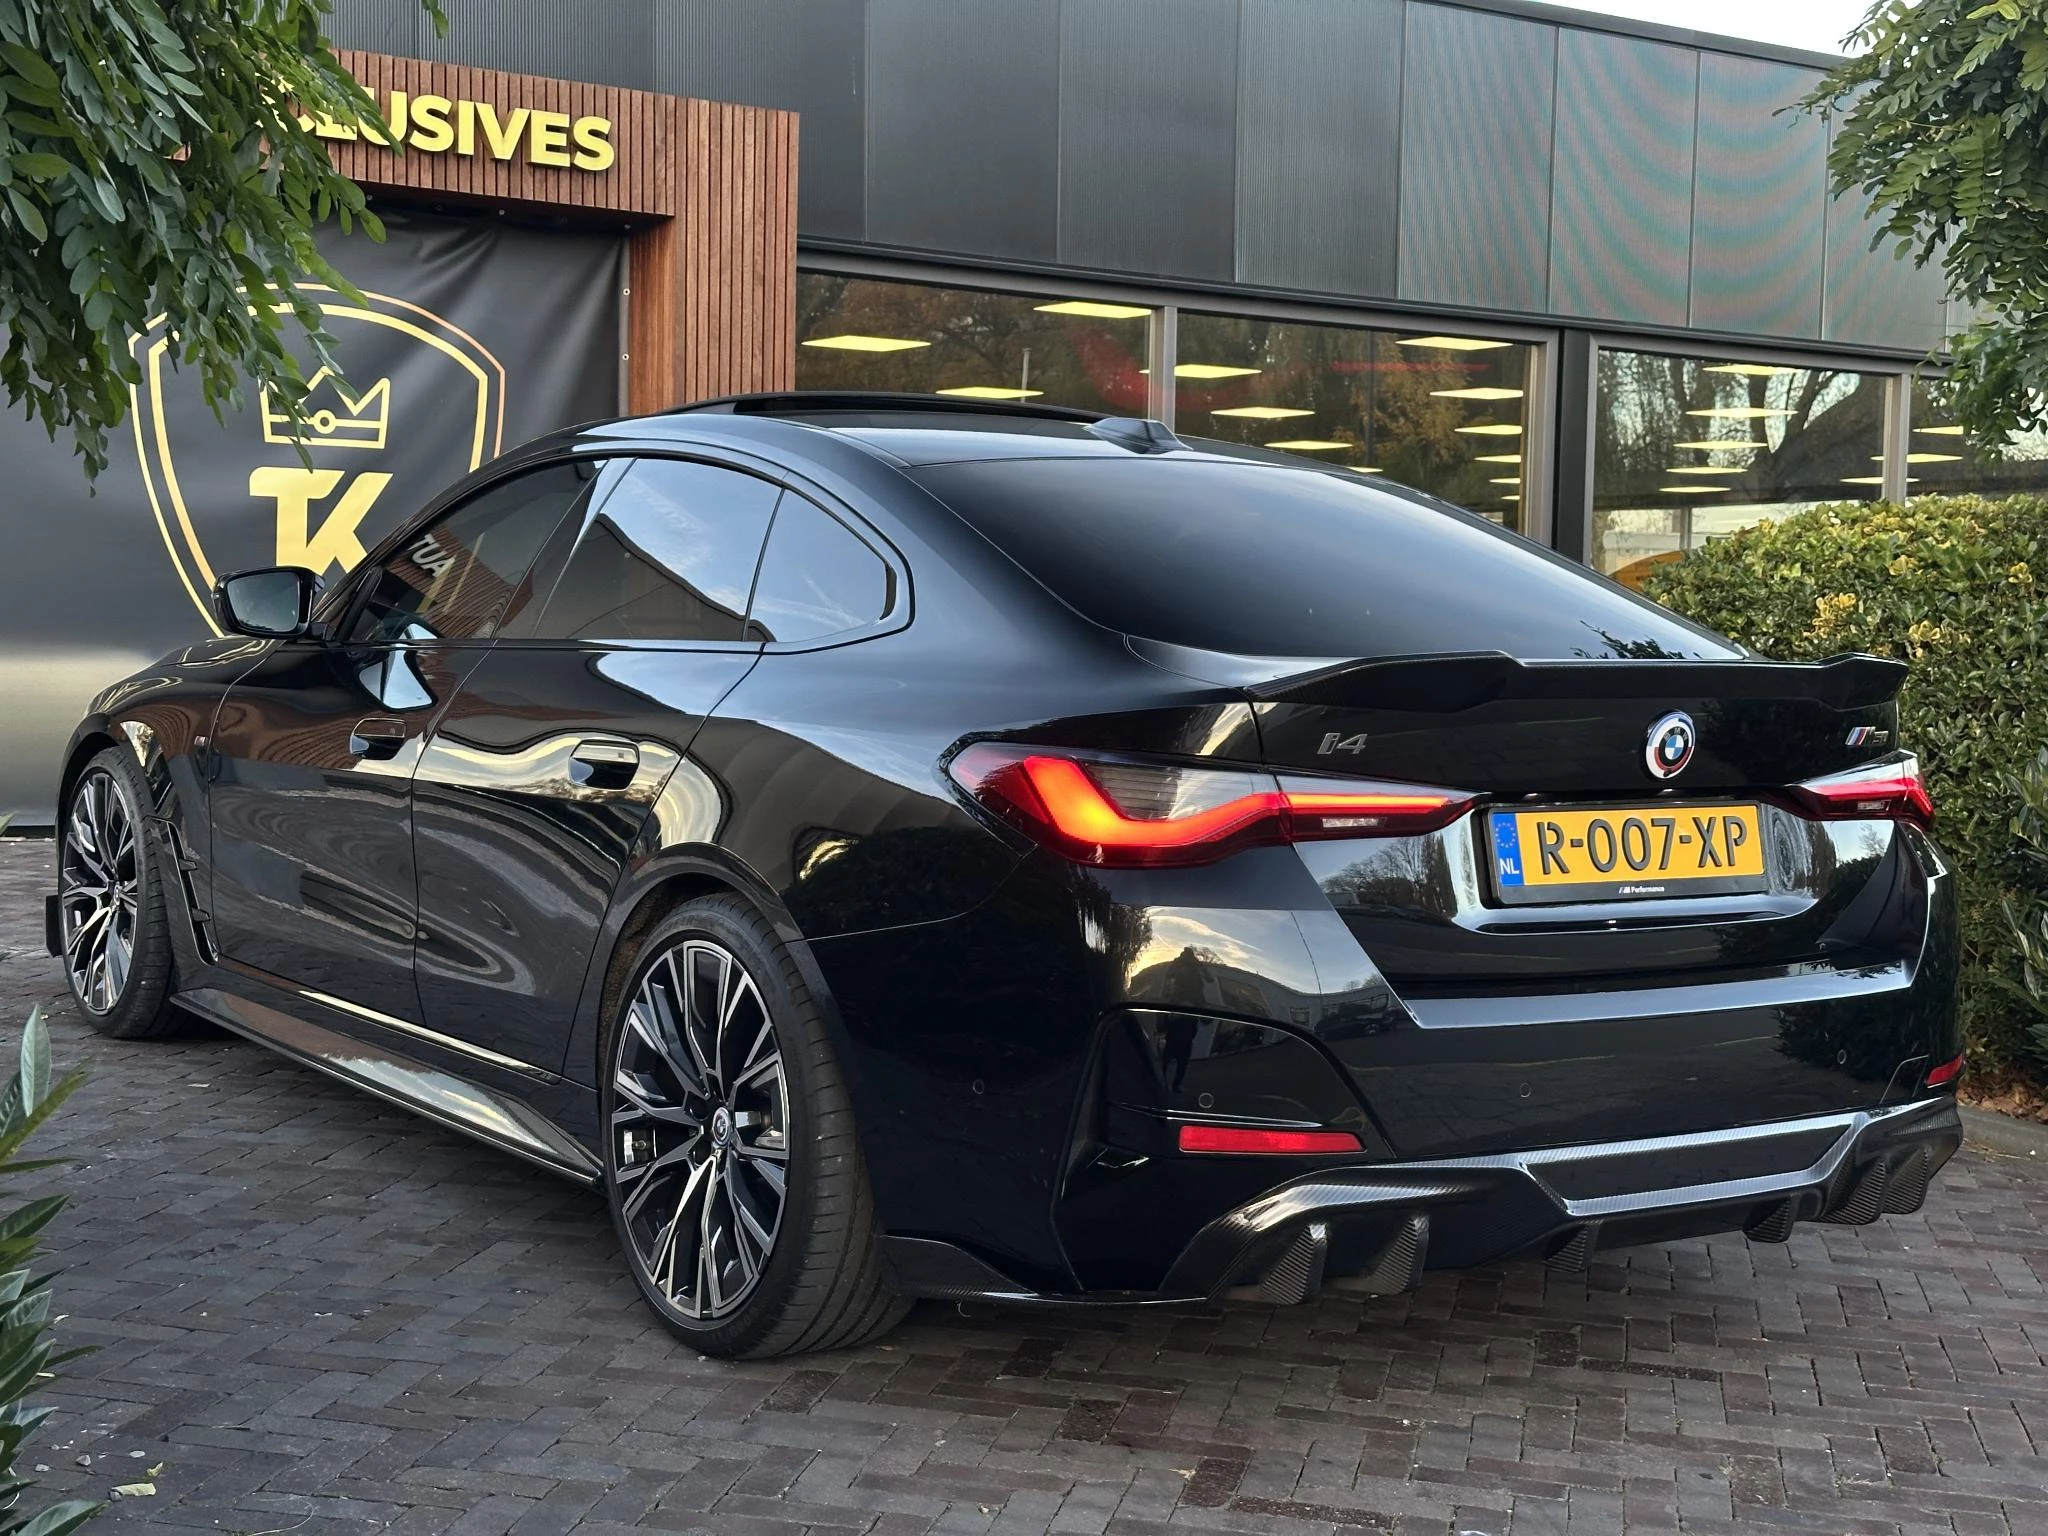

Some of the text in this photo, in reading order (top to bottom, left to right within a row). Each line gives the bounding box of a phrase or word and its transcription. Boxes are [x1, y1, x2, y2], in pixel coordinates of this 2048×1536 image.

[249, 467, 393, 577] TK
[1317, 732, 1368, 754] i4
[1537, 816, 1748, 874] R-007-XP
[1500, 857, 1519, 875] NL
